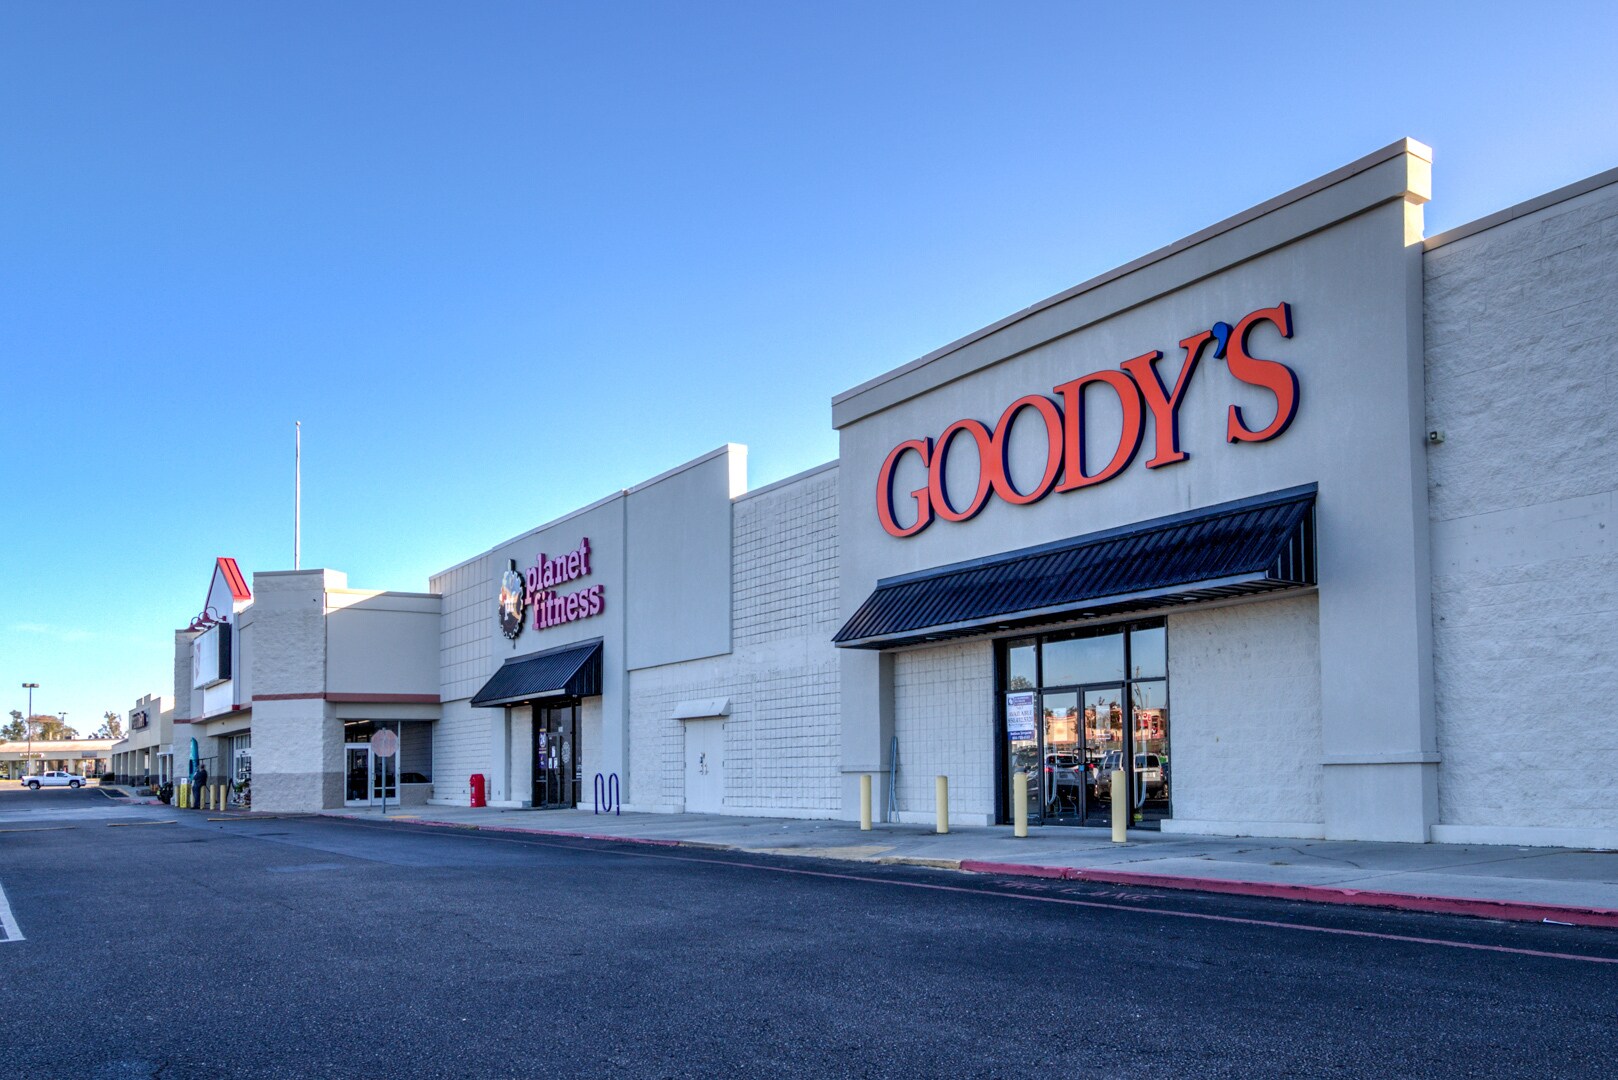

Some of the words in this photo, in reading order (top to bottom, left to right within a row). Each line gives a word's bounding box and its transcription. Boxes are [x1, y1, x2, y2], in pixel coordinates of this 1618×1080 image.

[876, 301, 1300, 538] GOODY'S
[524, 537, 591, 605] planet
[532, 584, 604, 630] fitness
